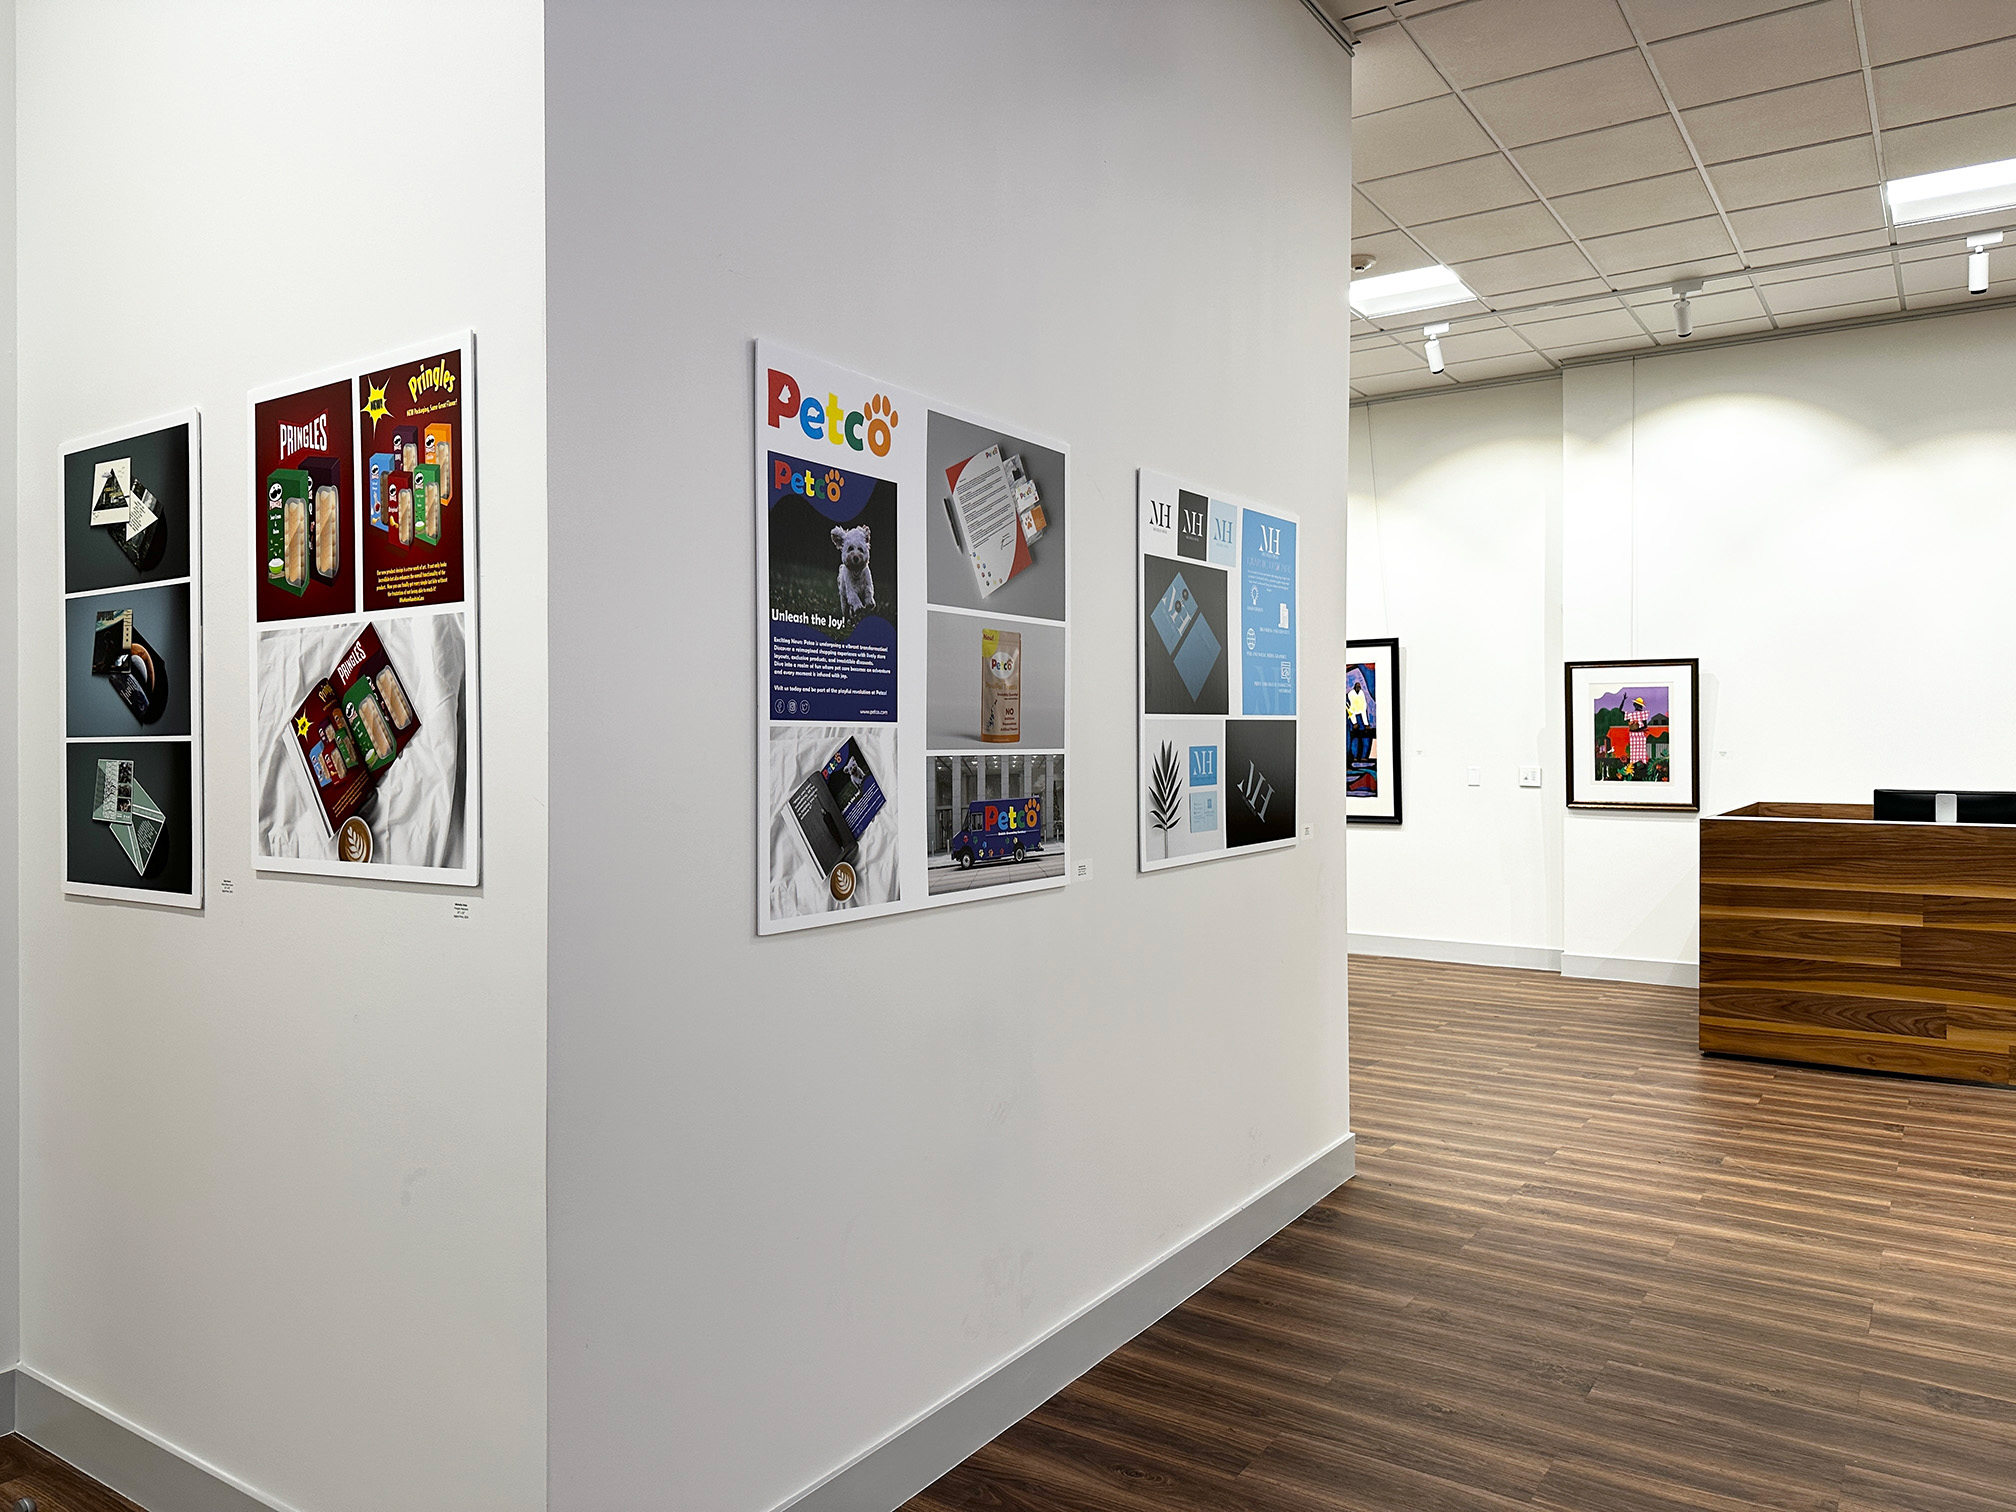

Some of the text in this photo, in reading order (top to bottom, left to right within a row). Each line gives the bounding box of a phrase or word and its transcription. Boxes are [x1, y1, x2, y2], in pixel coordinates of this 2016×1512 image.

[408, 358, 456, 403] Pringles
[768, 368, 892, 457] Petco
[280, 414, 327, 460] PRINGLES
[775, 460, 841, 502] Petco
[772, 608, 845, 629] Unleash the Joy!
[336, 640, 366, 685] PRINGLES
[992, 659, 1012, 670] Petco
[985, 802, 1038, 831] Petco
